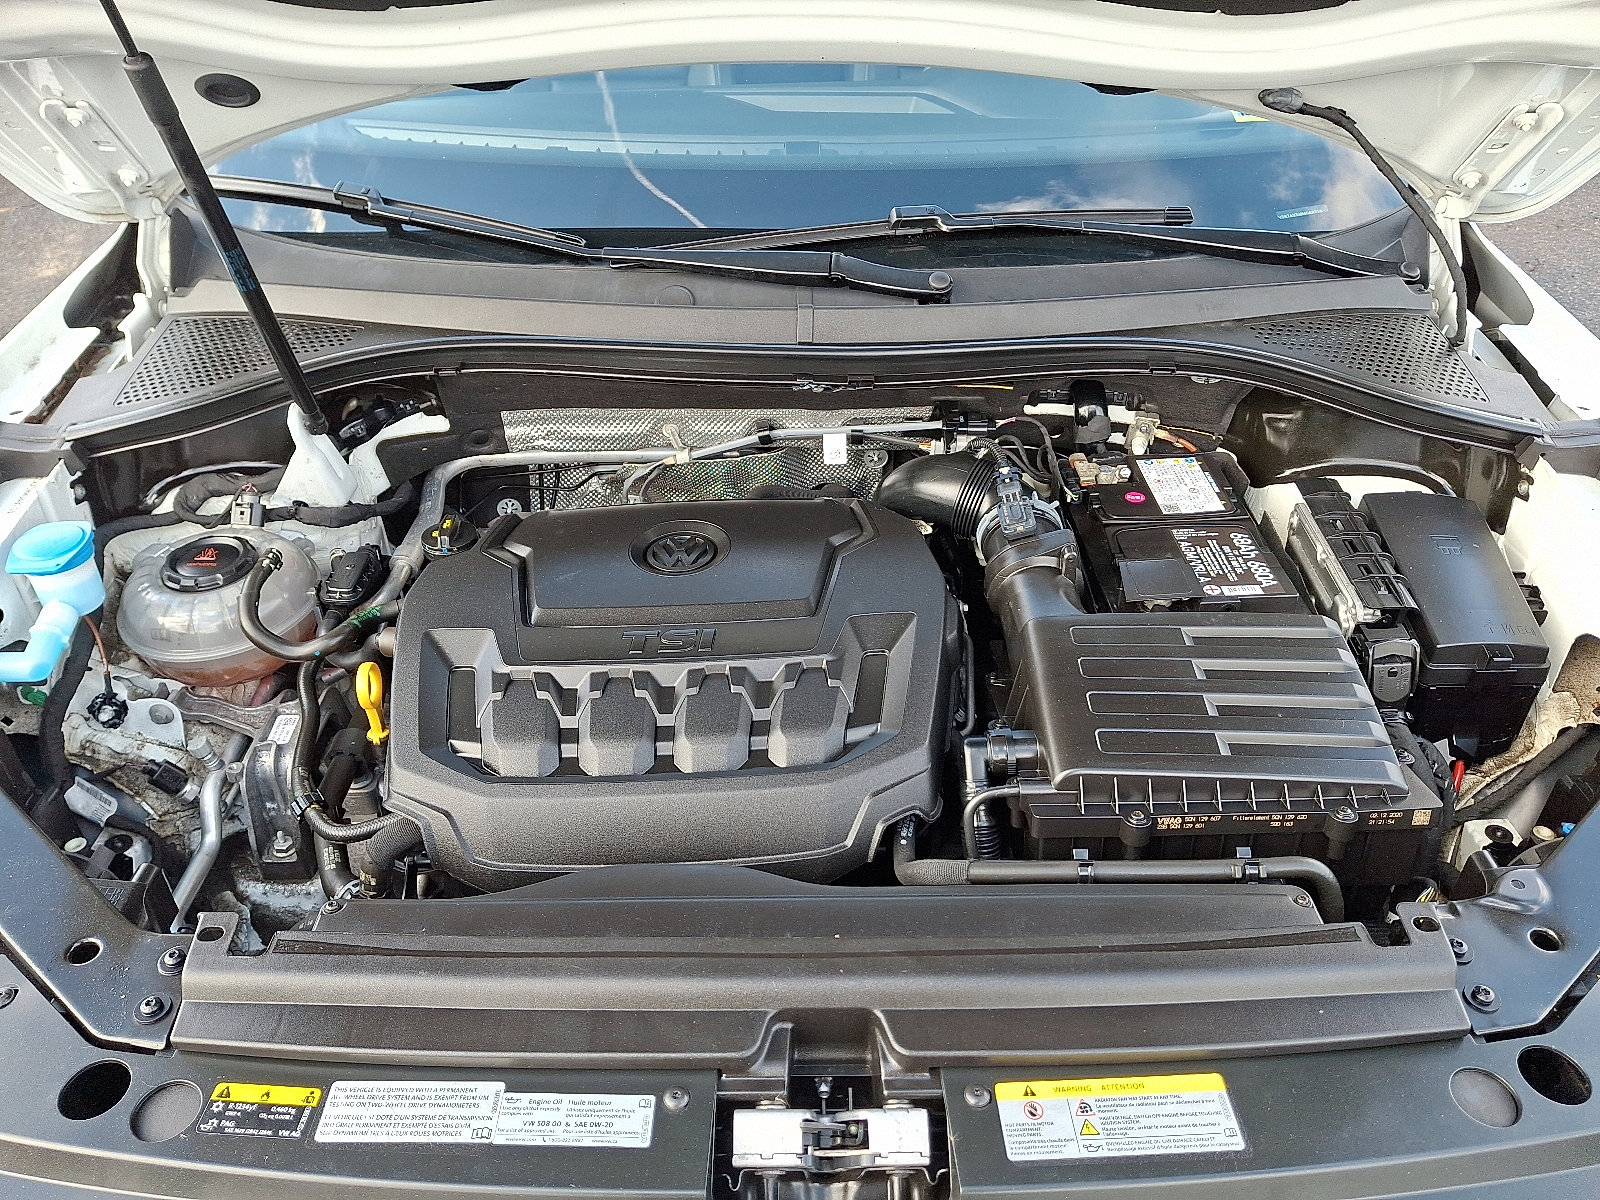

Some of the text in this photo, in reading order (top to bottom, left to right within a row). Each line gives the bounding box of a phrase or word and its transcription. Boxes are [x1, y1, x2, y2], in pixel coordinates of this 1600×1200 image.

[1230, 533, 1258, 558] 68Ah
[1178, 541, 1211, 583] AGM/VRLA
[1247, 561, 1278, 588] 680A
[622, 628, 717, 654] TSI
[1053, 1082, 1145, 1093] WARNING ATTENTION
